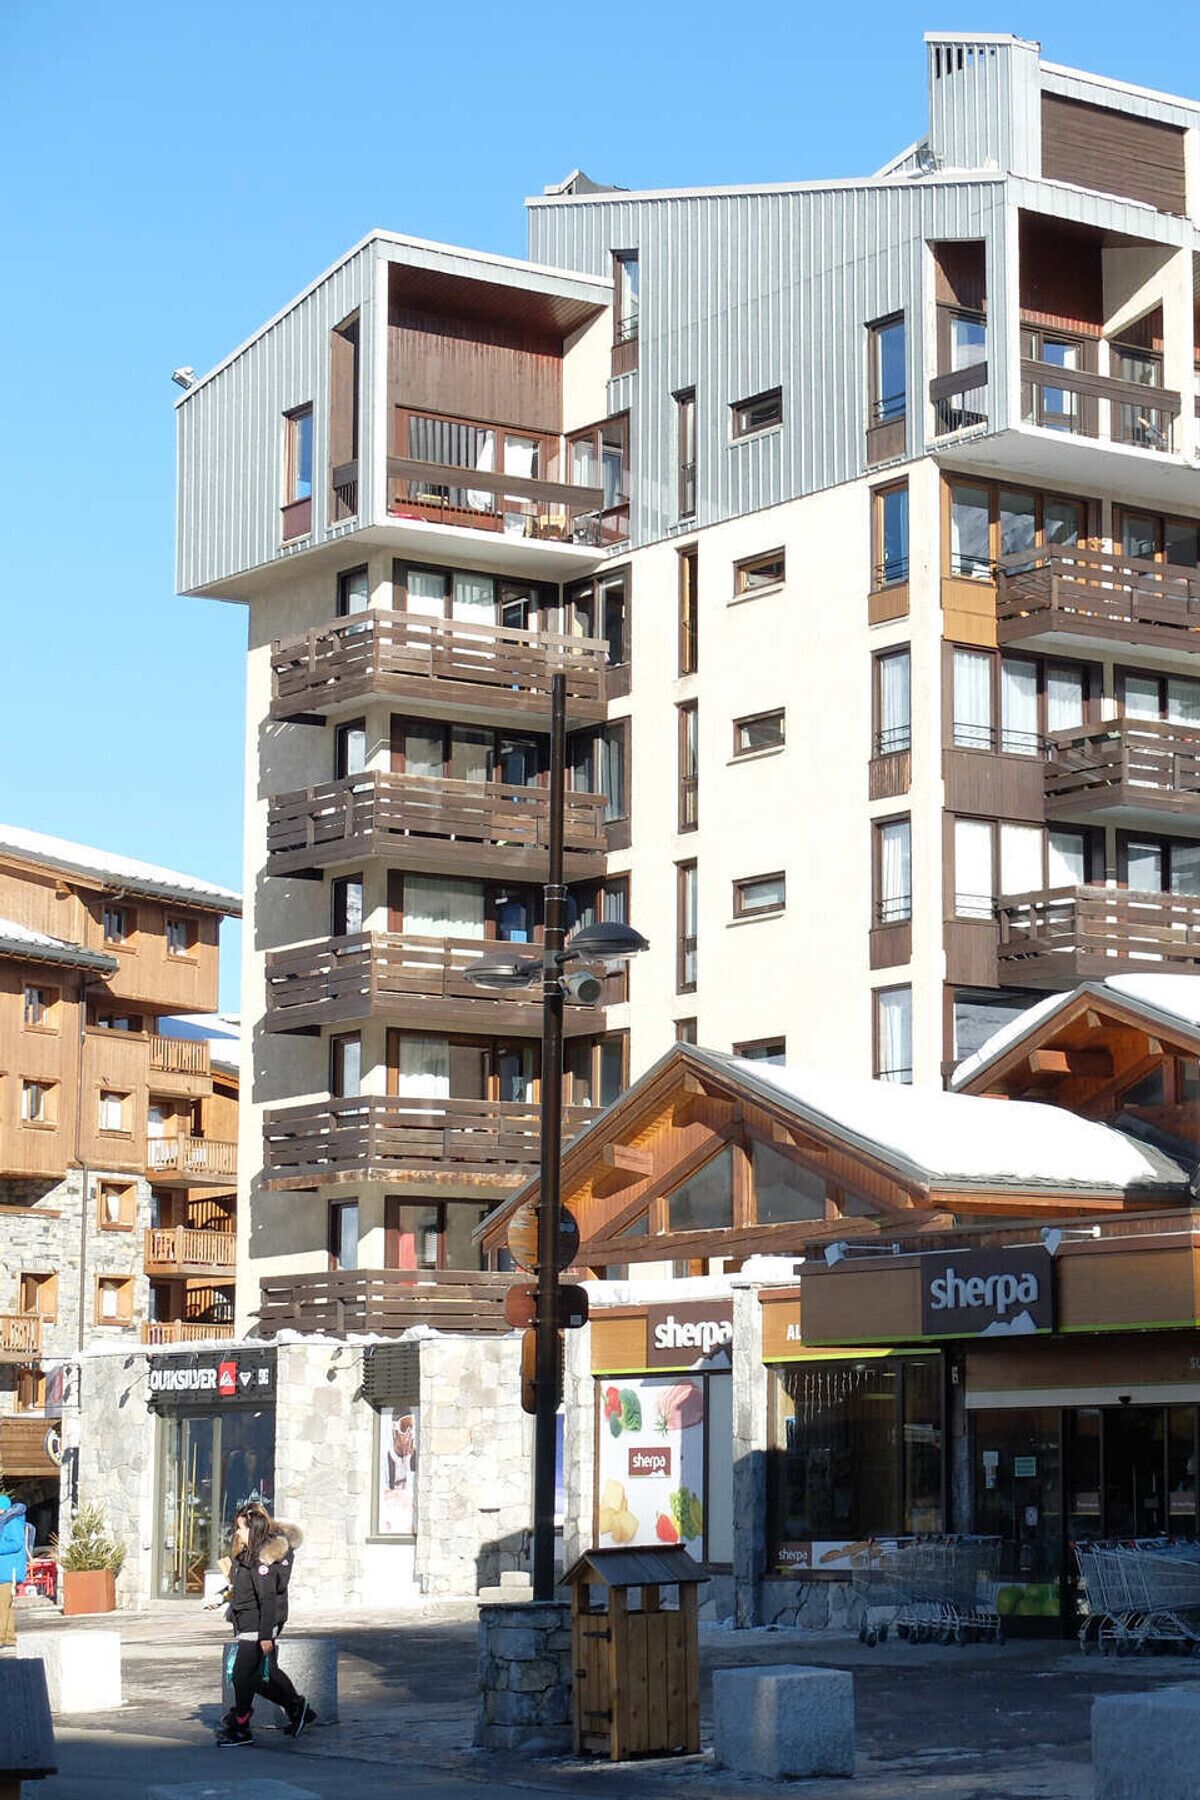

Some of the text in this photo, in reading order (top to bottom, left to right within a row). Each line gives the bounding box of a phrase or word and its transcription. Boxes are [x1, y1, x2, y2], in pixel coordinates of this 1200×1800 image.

[929, 1268, 1039, 1314] sherpa
[654, 1315, 733, 1353] sherpa
[150, 1368, 218, 1391] QUIKSILVER
[632, 1452, 666, 1470] sherpa
[778, 1547, 808, 1561] sherpa
